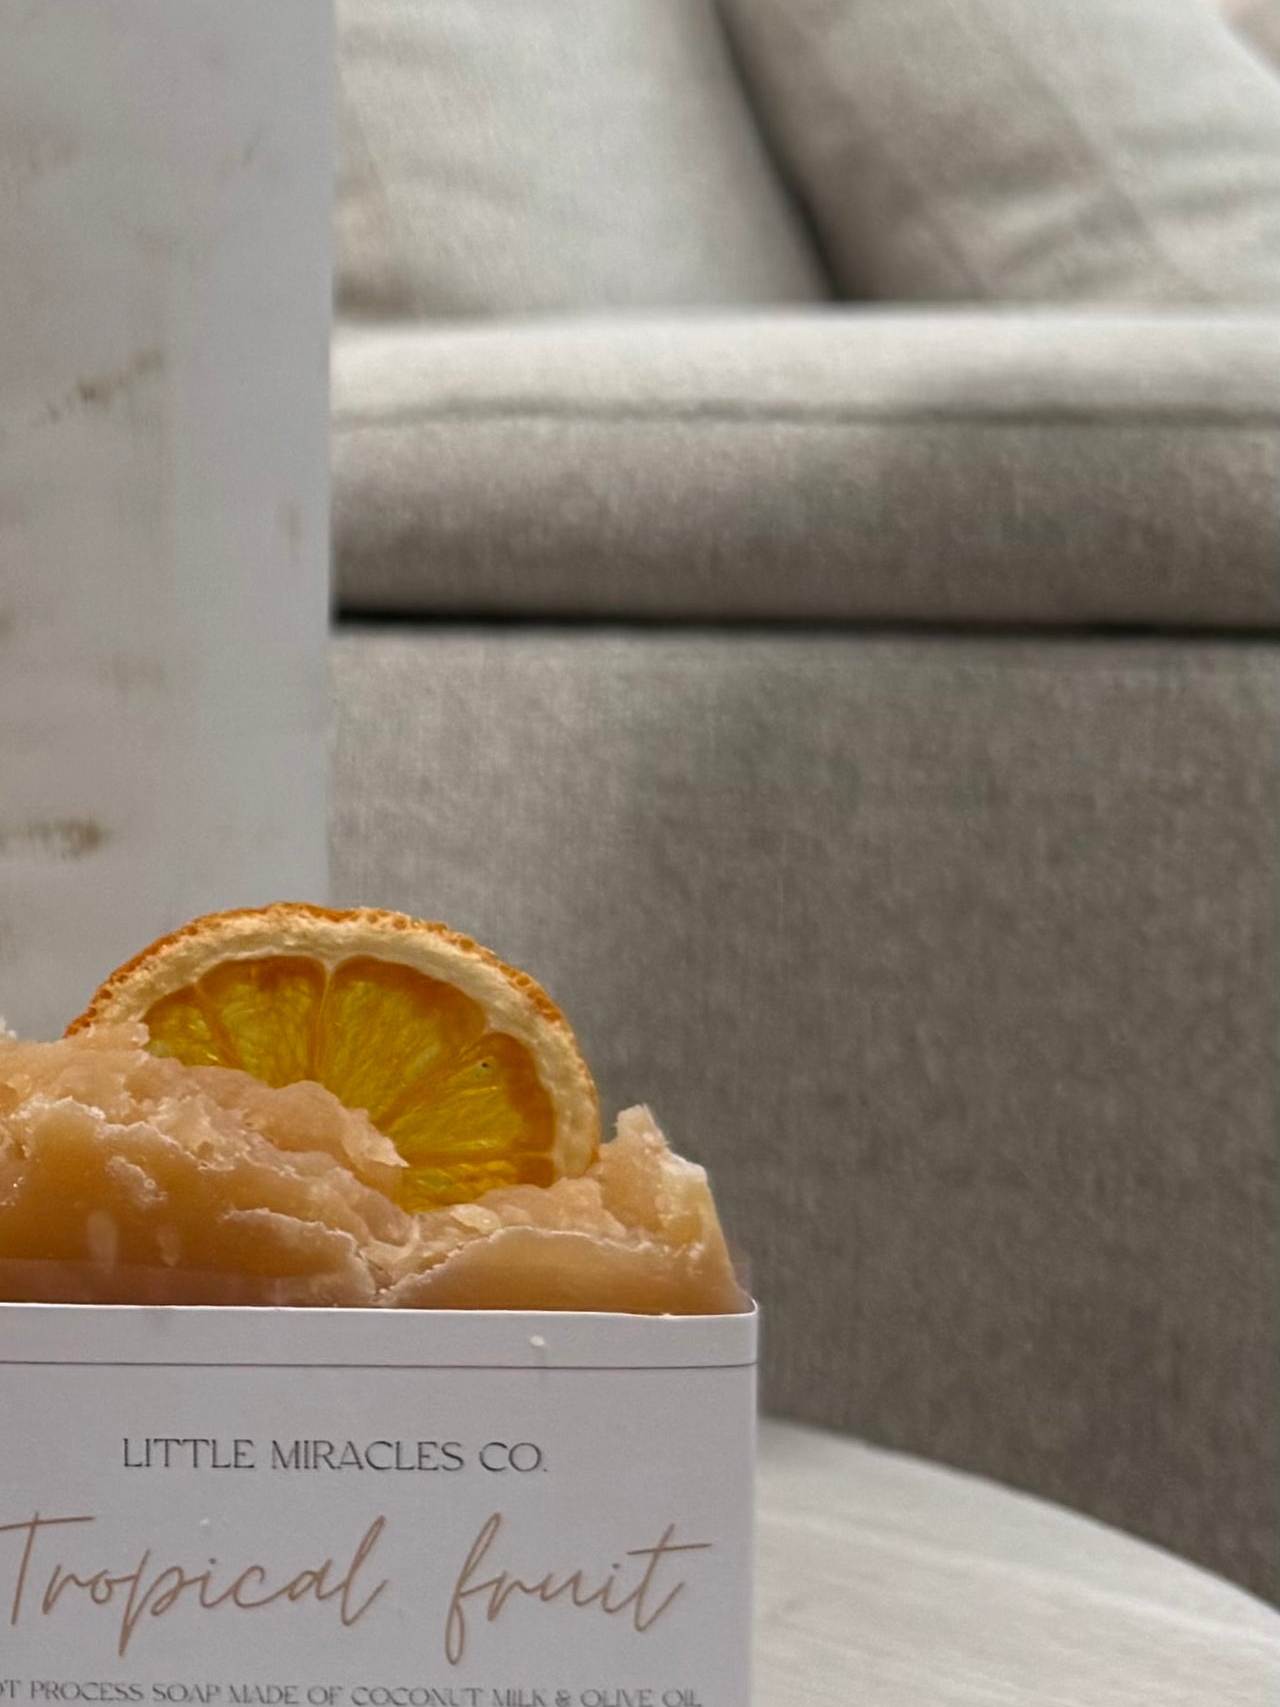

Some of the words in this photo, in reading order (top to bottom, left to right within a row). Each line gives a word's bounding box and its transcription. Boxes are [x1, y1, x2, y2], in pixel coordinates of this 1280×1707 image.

[122, 1437, 256, 1470] LITTLE
[271, 1439, 466, 1473] MIRACLES
[478, 1441, 548, 1474] CO.
[445, 1513, 712, 1666] fruit
[30, 1680, 145, 1702] PROCESS
[152, 1683, 219, 1704] SOAP
[228, 1684, 300, 1705] MADE
[306, 1685, 344, 1706] OF
[350, 1686, 484, 1707] COCONUT
